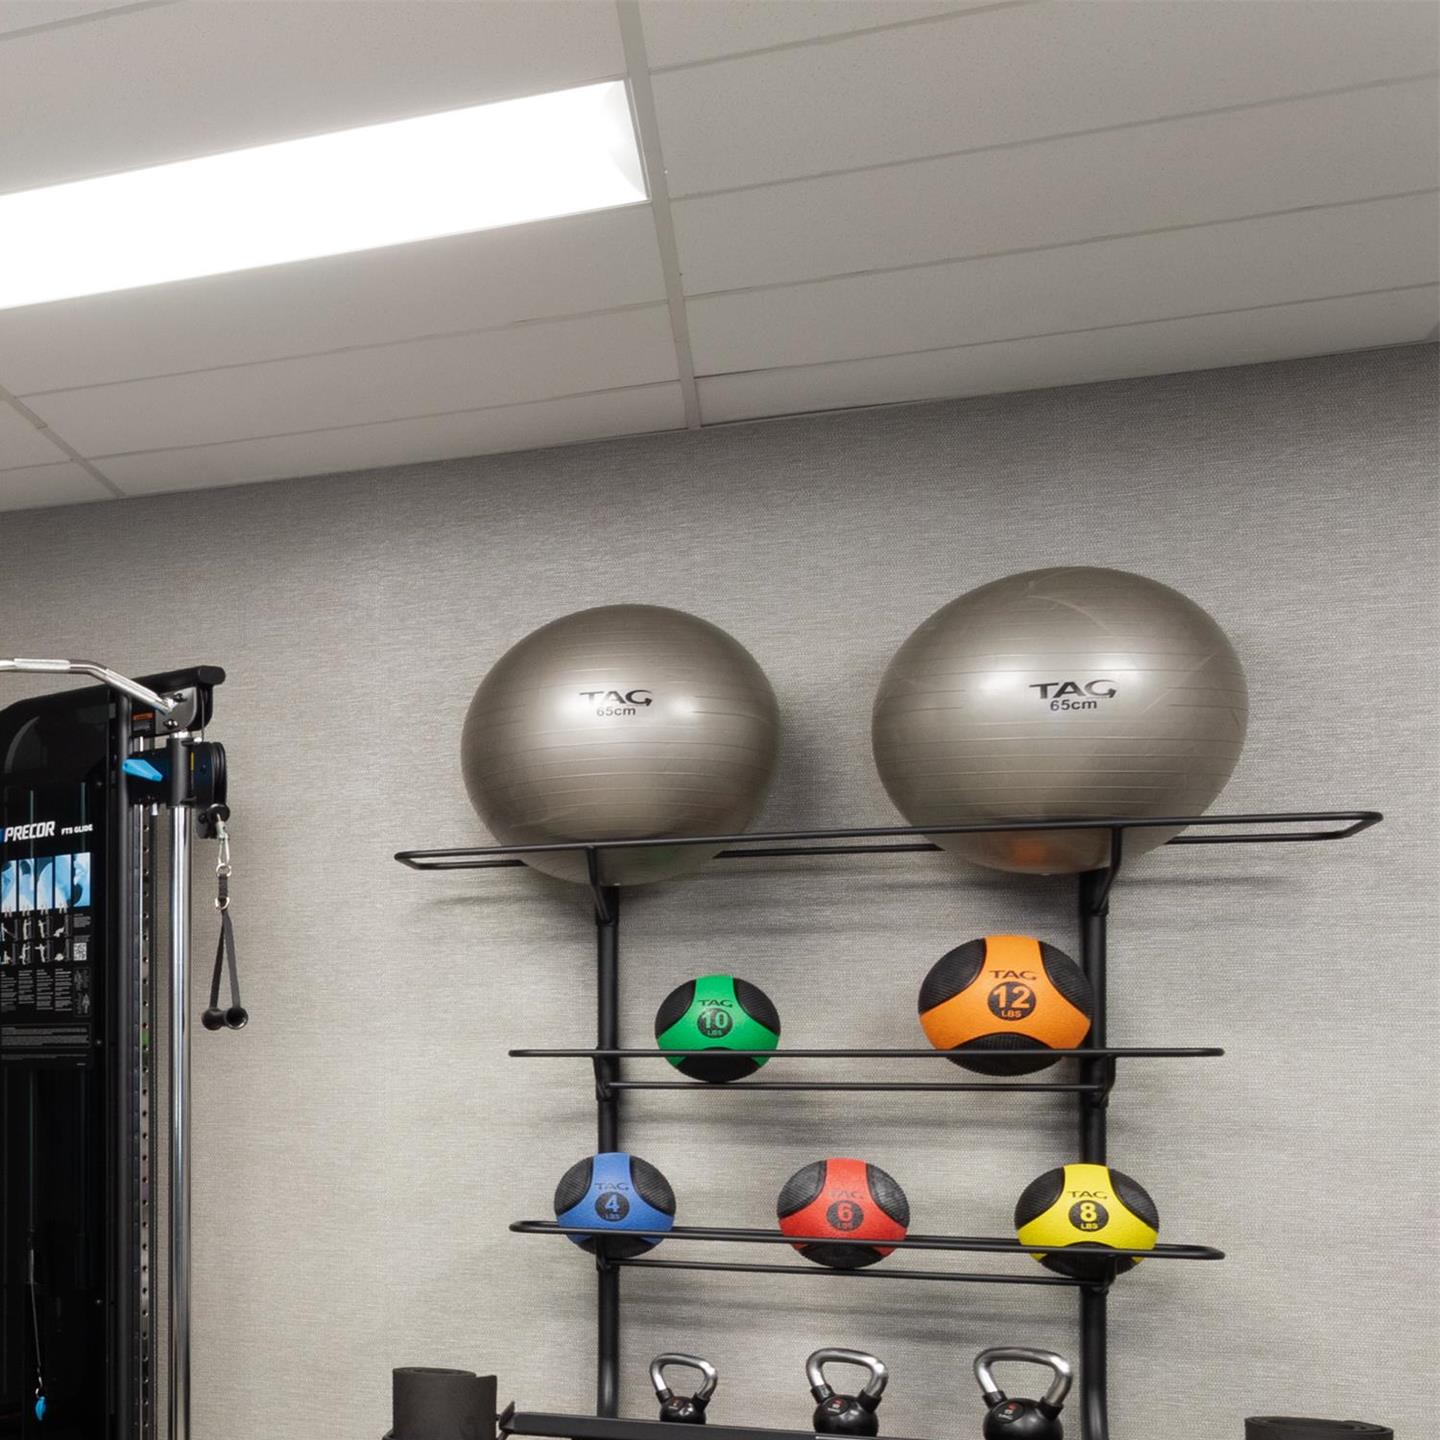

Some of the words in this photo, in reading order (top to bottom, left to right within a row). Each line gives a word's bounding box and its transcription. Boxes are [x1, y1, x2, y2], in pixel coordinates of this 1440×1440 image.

[579, 689, 652, 706] TAG
[1028, 679, 1118, 699] TAG
[596, 707, 636, 717] 65cm
[1049, 699, 1098, 712] 65cm
[4, 820, 56, 843] PRECOR
[988, 970, 1038, 981] TAG
[697, 999, 733, 1008] TAG
[993, 985, 1030, 1009] 12
[703, 1010, 729, 1030] 10
[1001, 1009, 1022, 1019] LBS
[604, 1193, 620, 1213] 4
[1067, 1190, 1108, 1200] TAG
[837, 1202, 853, 1223] 6
[1080, 1201, 1098, 1222] 8
